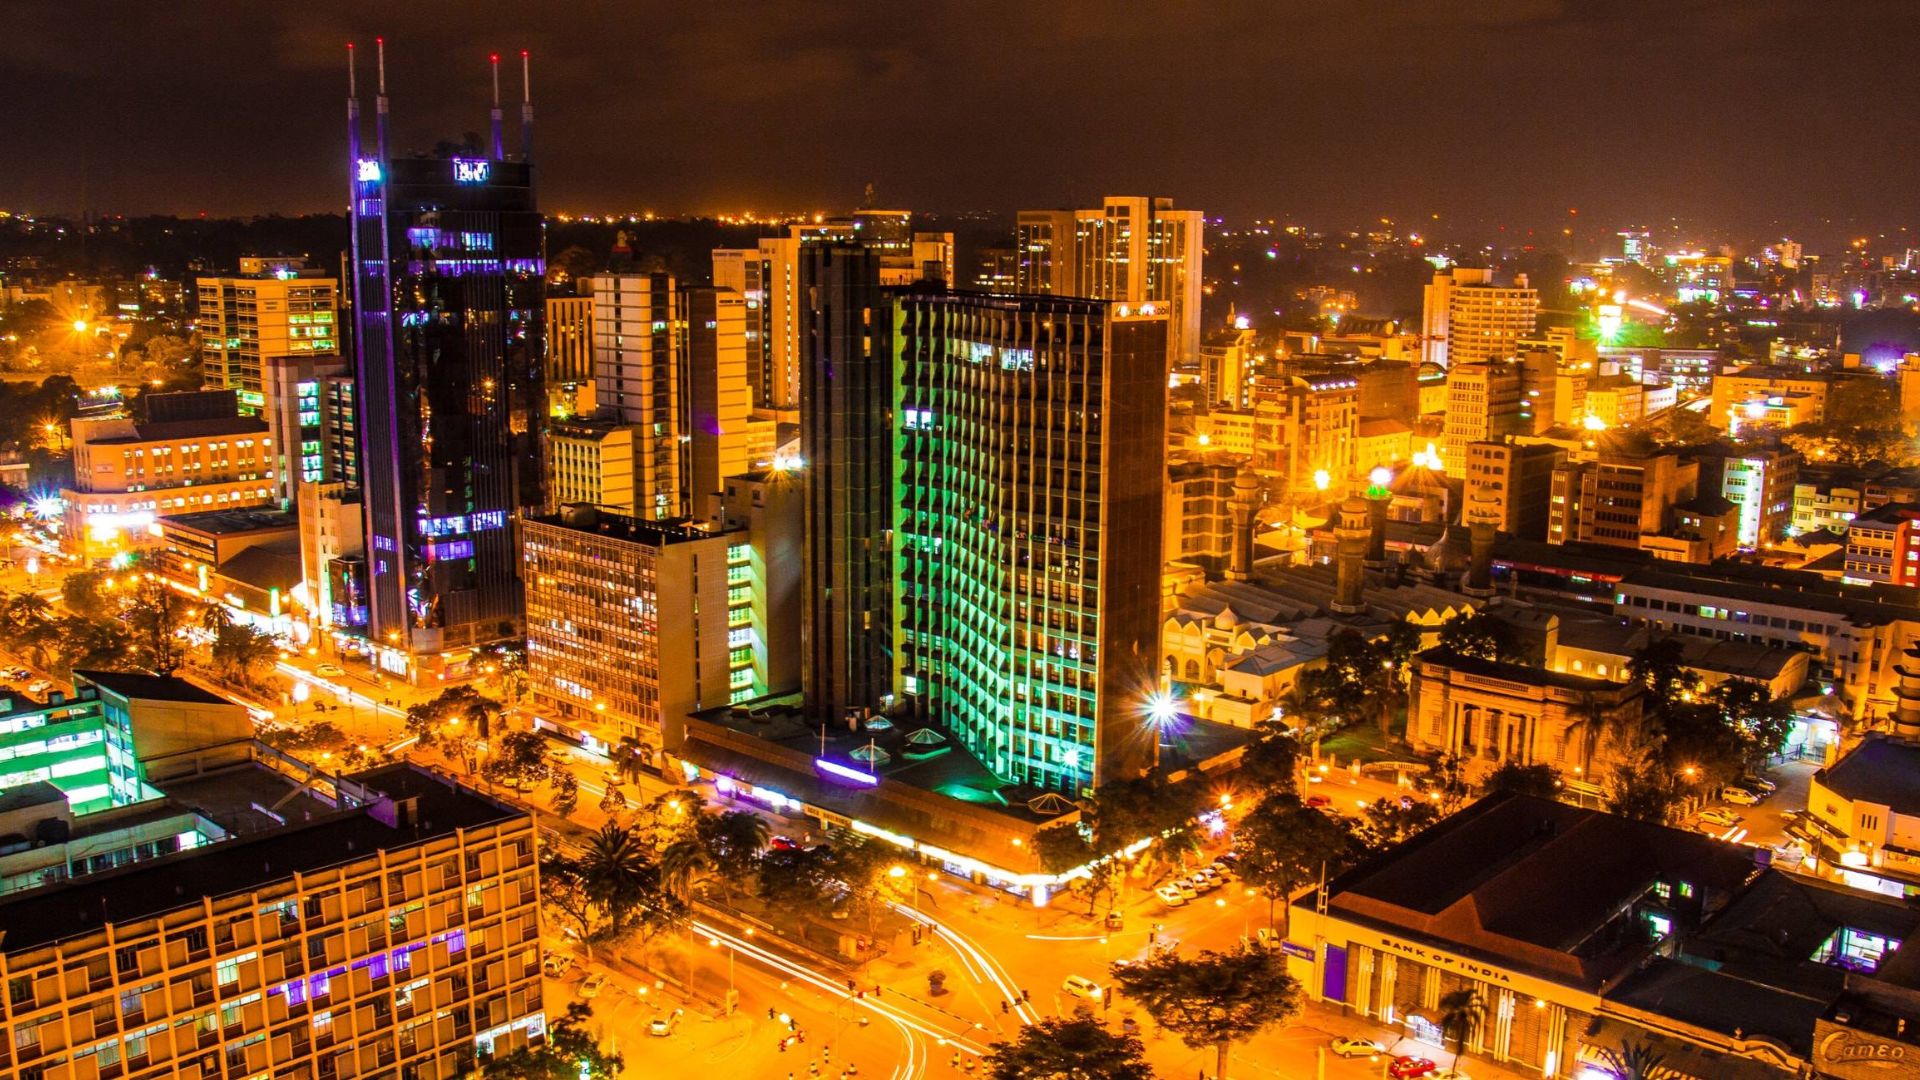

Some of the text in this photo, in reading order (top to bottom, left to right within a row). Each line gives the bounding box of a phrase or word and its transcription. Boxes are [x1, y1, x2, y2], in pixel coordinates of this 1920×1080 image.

[1381, 939, 1511, 983] BANK OF INDIA
